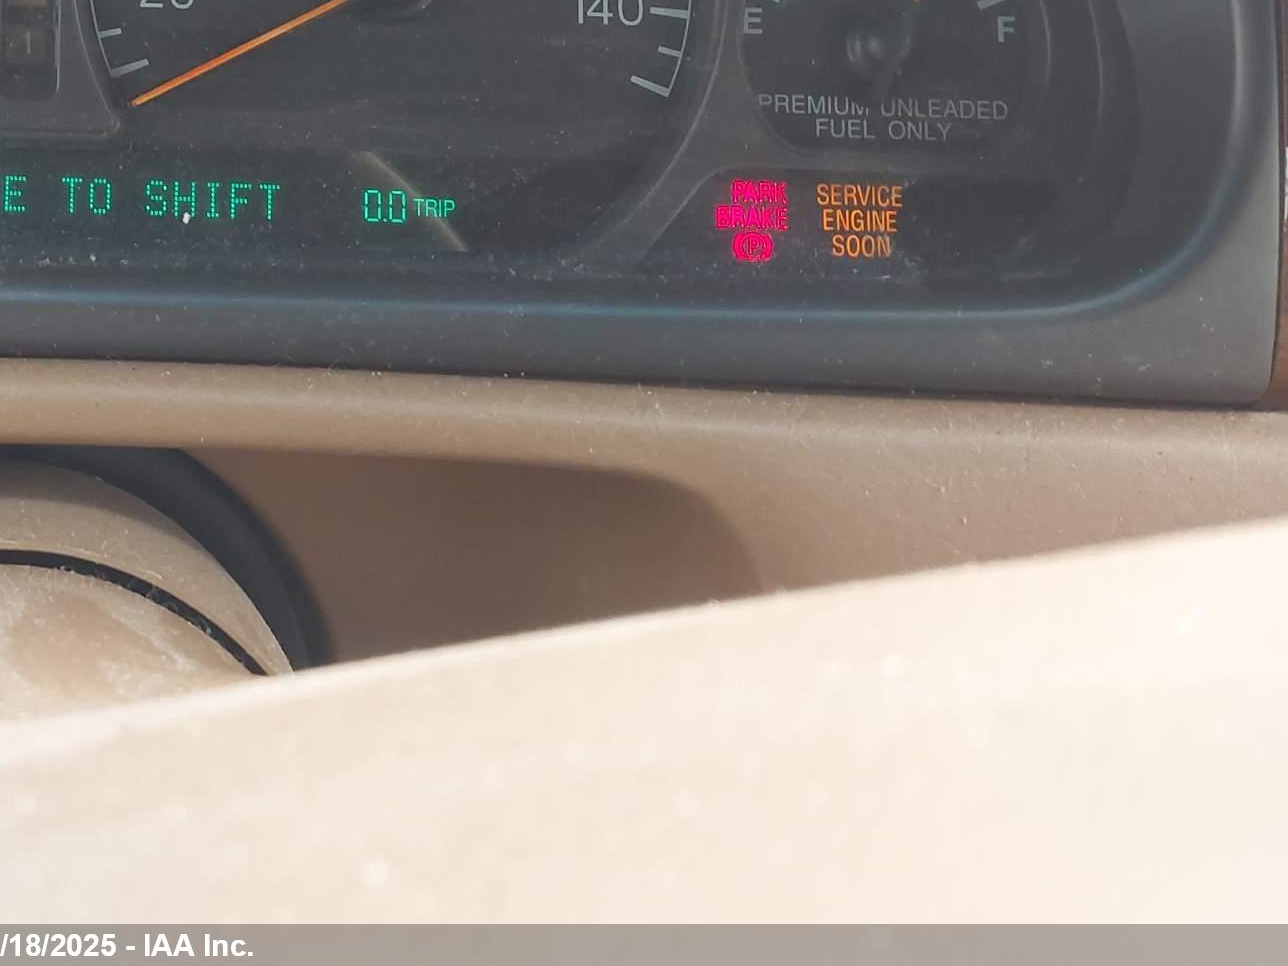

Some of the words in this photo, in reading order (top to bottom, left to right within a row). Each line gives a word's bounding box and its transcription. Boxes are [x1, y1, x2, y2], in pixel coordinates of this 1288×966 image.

[743, 7, 763, 34] E
[997, 16, 1015, 42] F
[880, 98, 1008, 120] UNLEADED
[815, 118, 876, 139] FUEL
[888, 120, 952, 141] ONLY
[61, 176, 111, 215] TO
[144, 179, 281, 221] SHIFT
[732, 180, 787, 203] PARK
[816, 184, 904, 208] SERVICE
[413, 198, 456, 218] TRIP
[716, 205, 789, 231] BRAKE
[822, 209, 898, 233] ENGINE
[831, 234, 893, 258] SOON
